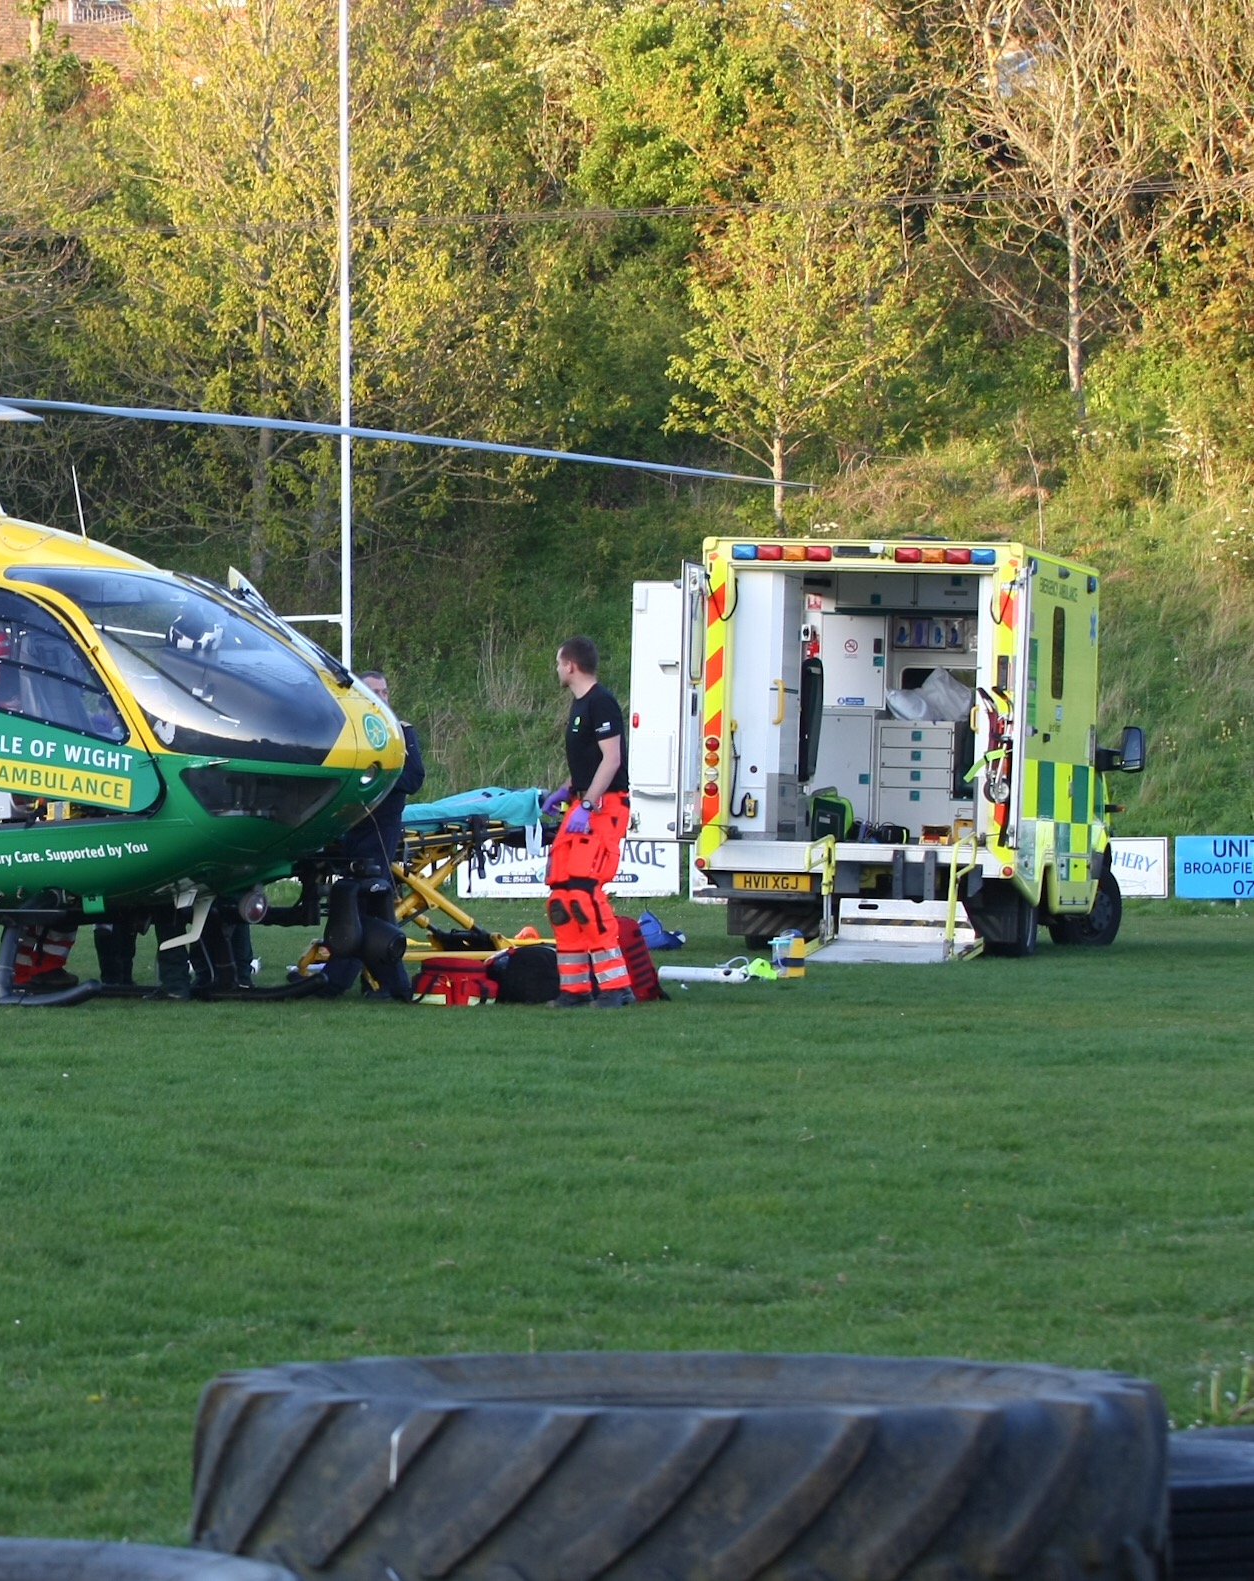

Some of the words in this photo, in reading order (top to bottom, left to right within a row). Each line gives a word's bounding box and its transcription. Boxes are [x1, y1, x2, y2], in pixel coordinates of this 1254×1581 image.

[30, 739, 57, 759] OF
[63, 744, 133, 772] WIGHT
[14, 850, 44, 863] Care.
[45, 844, 106, 863] Supported
[107, 843, 122, 858] by
[124, 842, 149, 855] You
[1111, 850, 1158, 872] HERY
[1183, 862, 1253, 875] BROADFIE
[744, 875, 768, 888] HV11
[772, 876, 799, 889] XGJ
